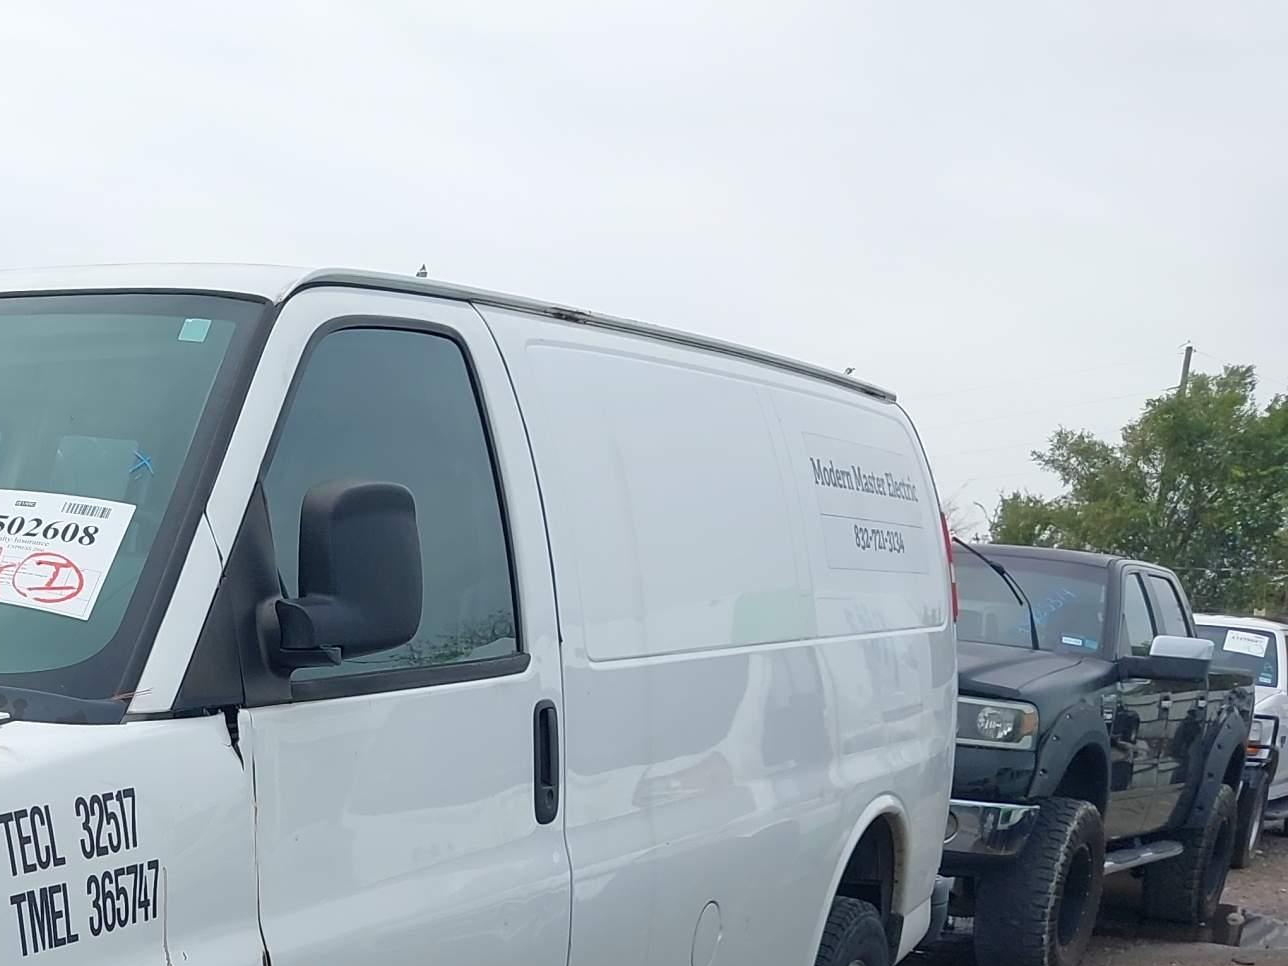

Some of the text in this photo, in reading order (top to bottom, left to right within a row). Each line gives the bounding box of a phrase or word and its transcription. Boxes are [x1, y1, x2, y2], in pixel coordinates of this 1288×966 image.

[810, 457, 918, 502] Modern Master Electric
[75, 788, 137, 859] 32517
[10, 859, 159, 956] TMEL 365747
